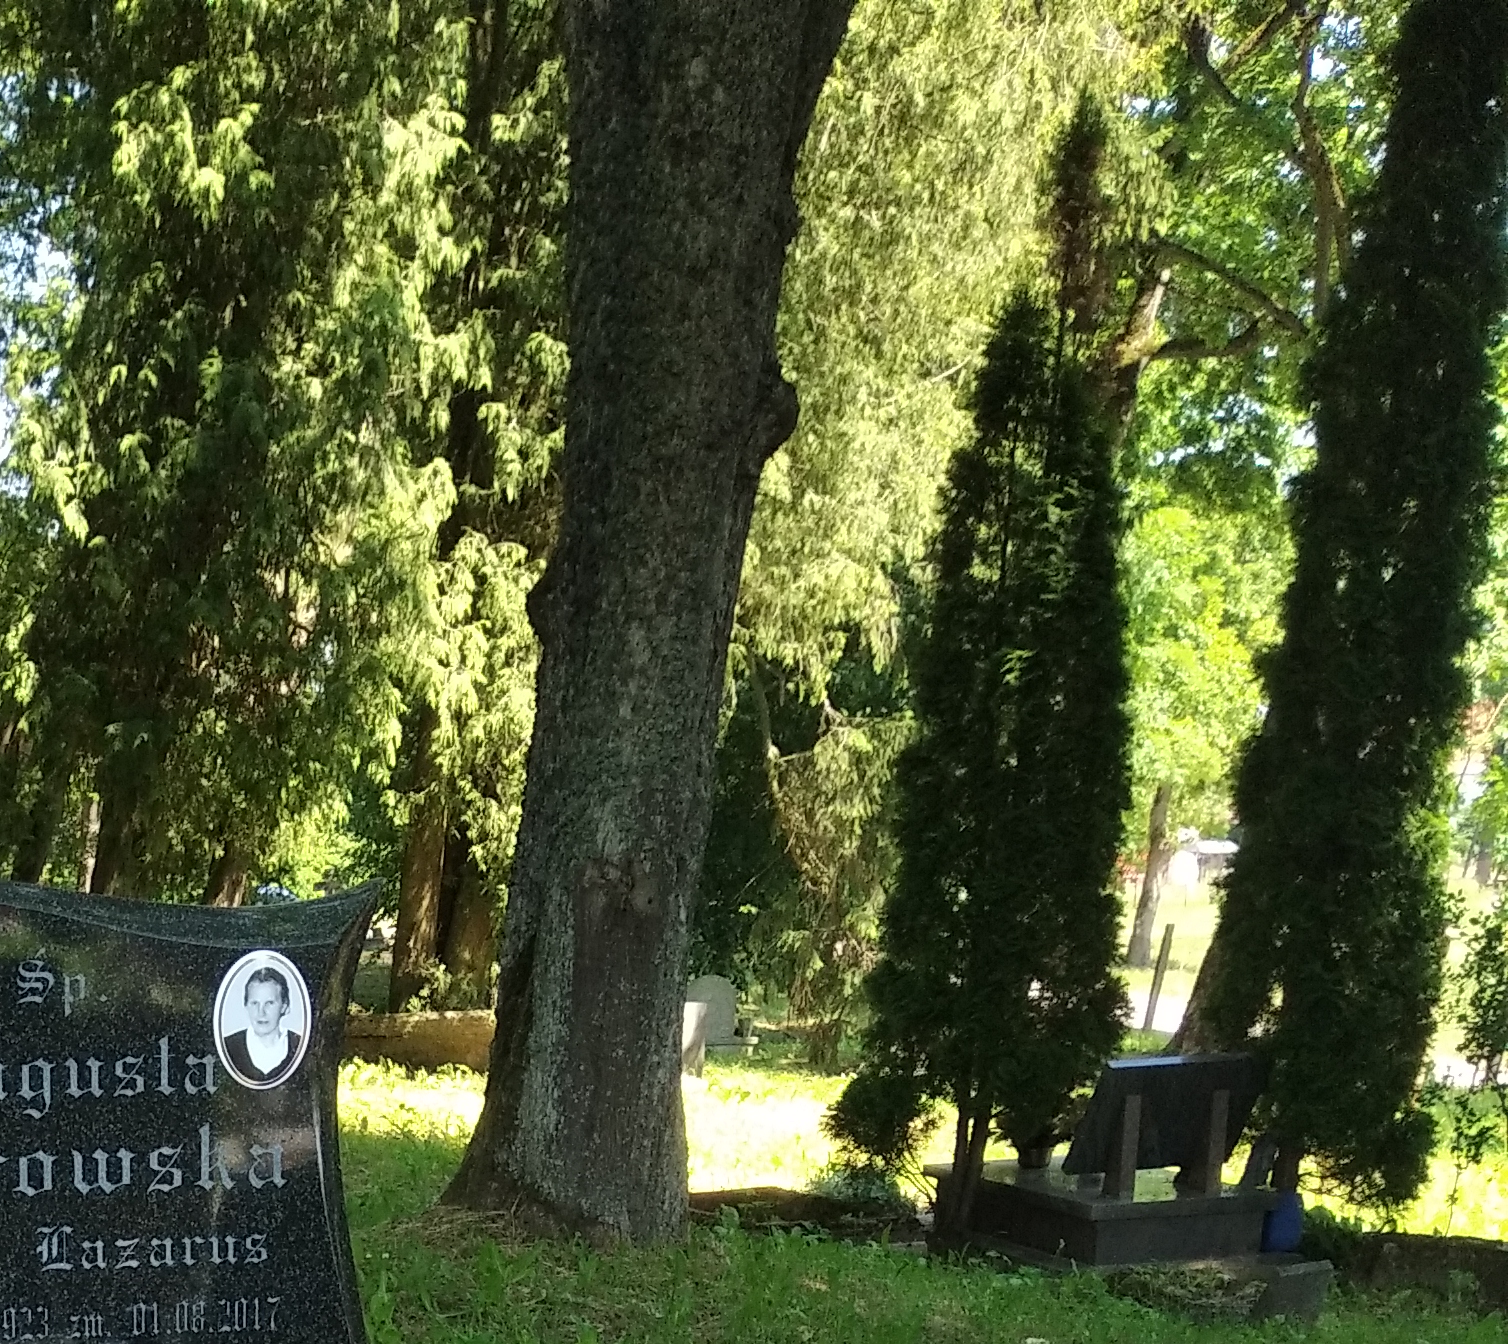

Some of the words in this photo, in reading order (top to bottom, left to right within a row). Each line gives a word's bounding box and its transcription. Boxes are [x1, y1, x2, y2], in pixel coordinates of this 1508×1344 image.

[35, 1224, 270, 1273] Lazarus
[68, 1311, 112, 1340] zm.
[131, 1296, 282, 1336] 01.08.2017
